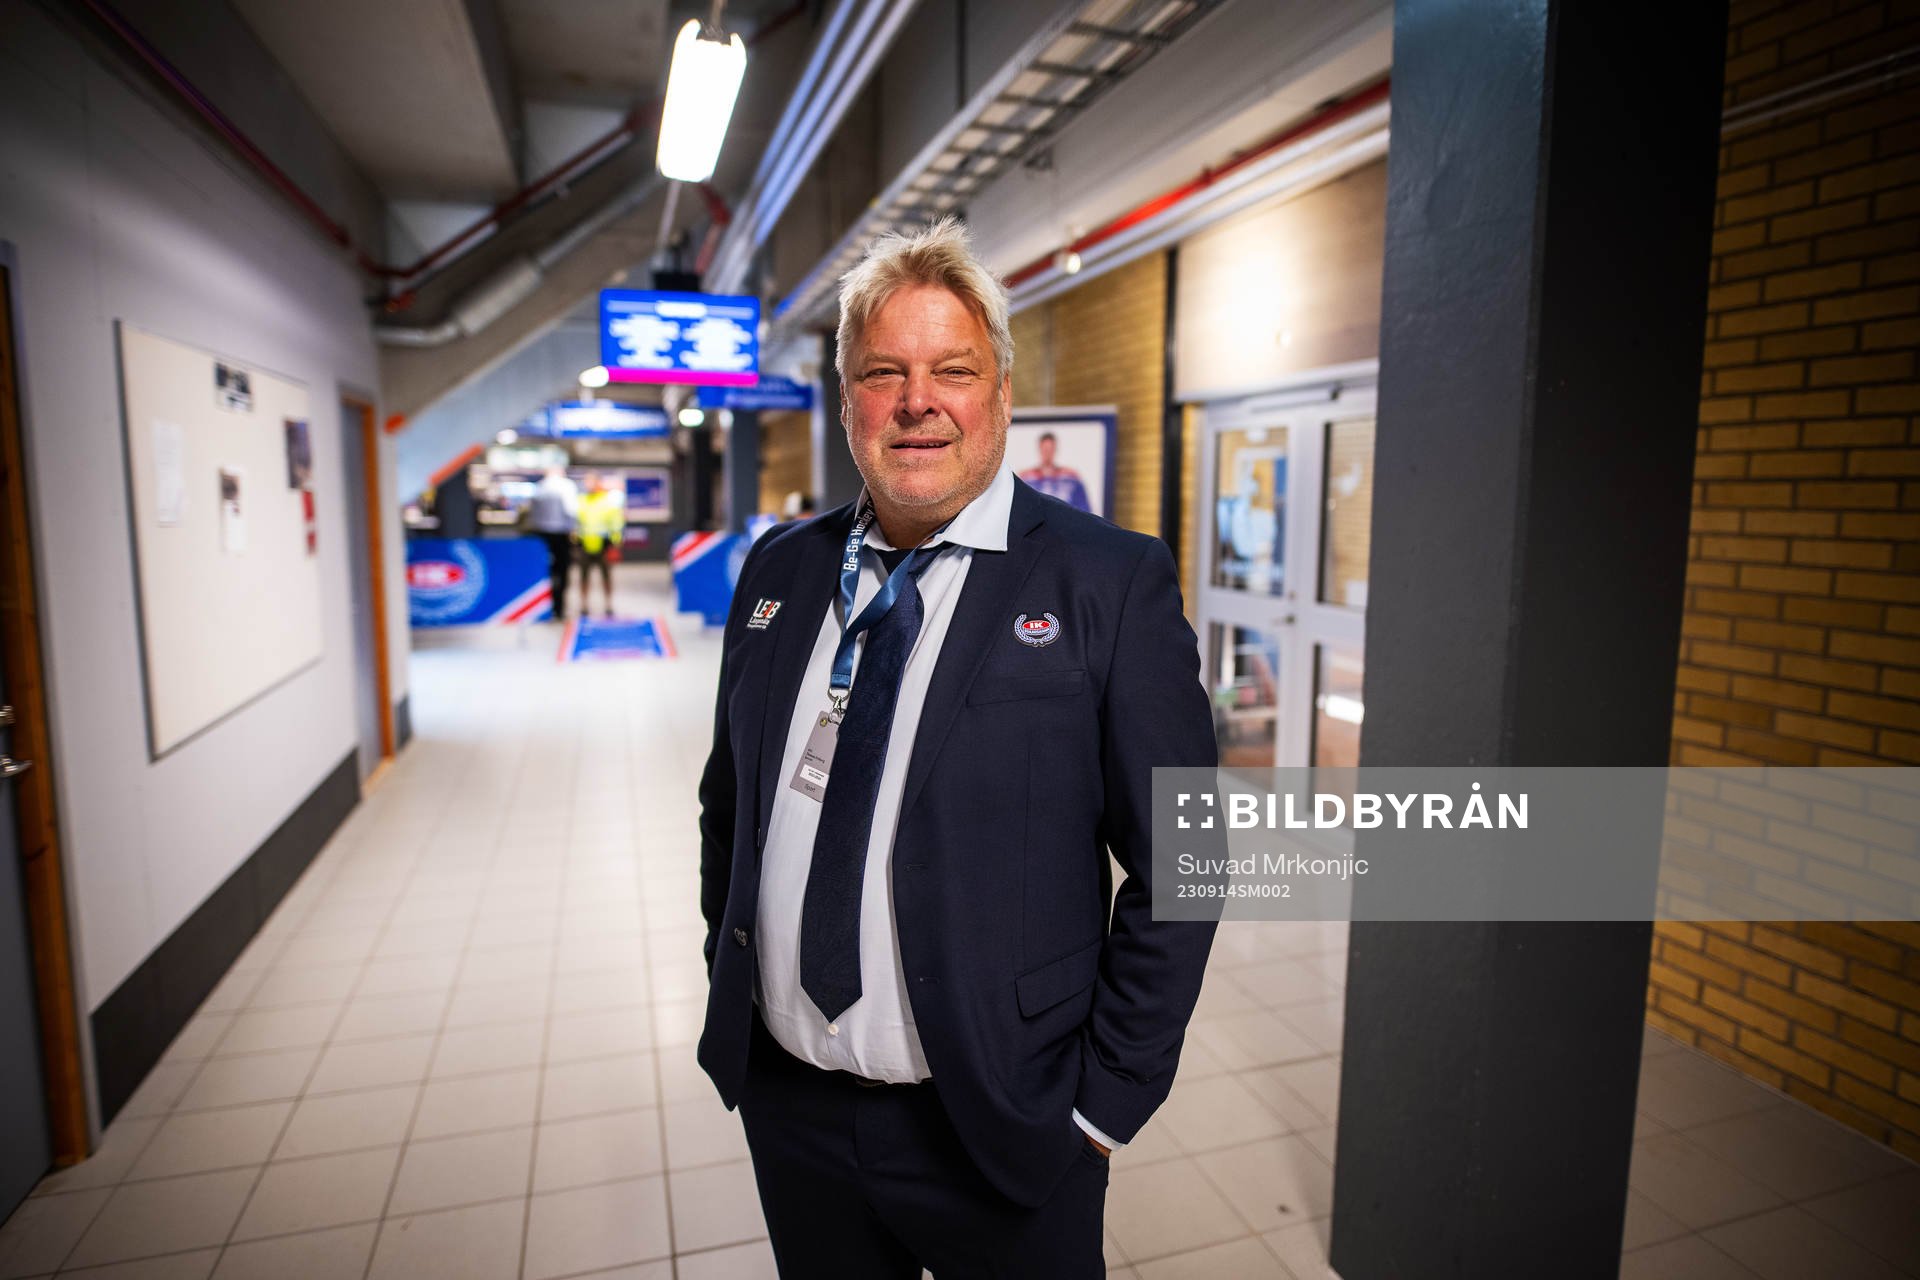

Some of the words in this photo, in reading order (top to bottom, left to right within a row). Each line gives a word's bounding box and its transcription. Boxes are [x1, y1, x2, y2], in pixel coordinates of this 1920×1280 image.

[851, 509, 876, 536] Hockey
[843, 538, 860, 572] Be-Ge
[1030, 621, 1044, 629] IK
